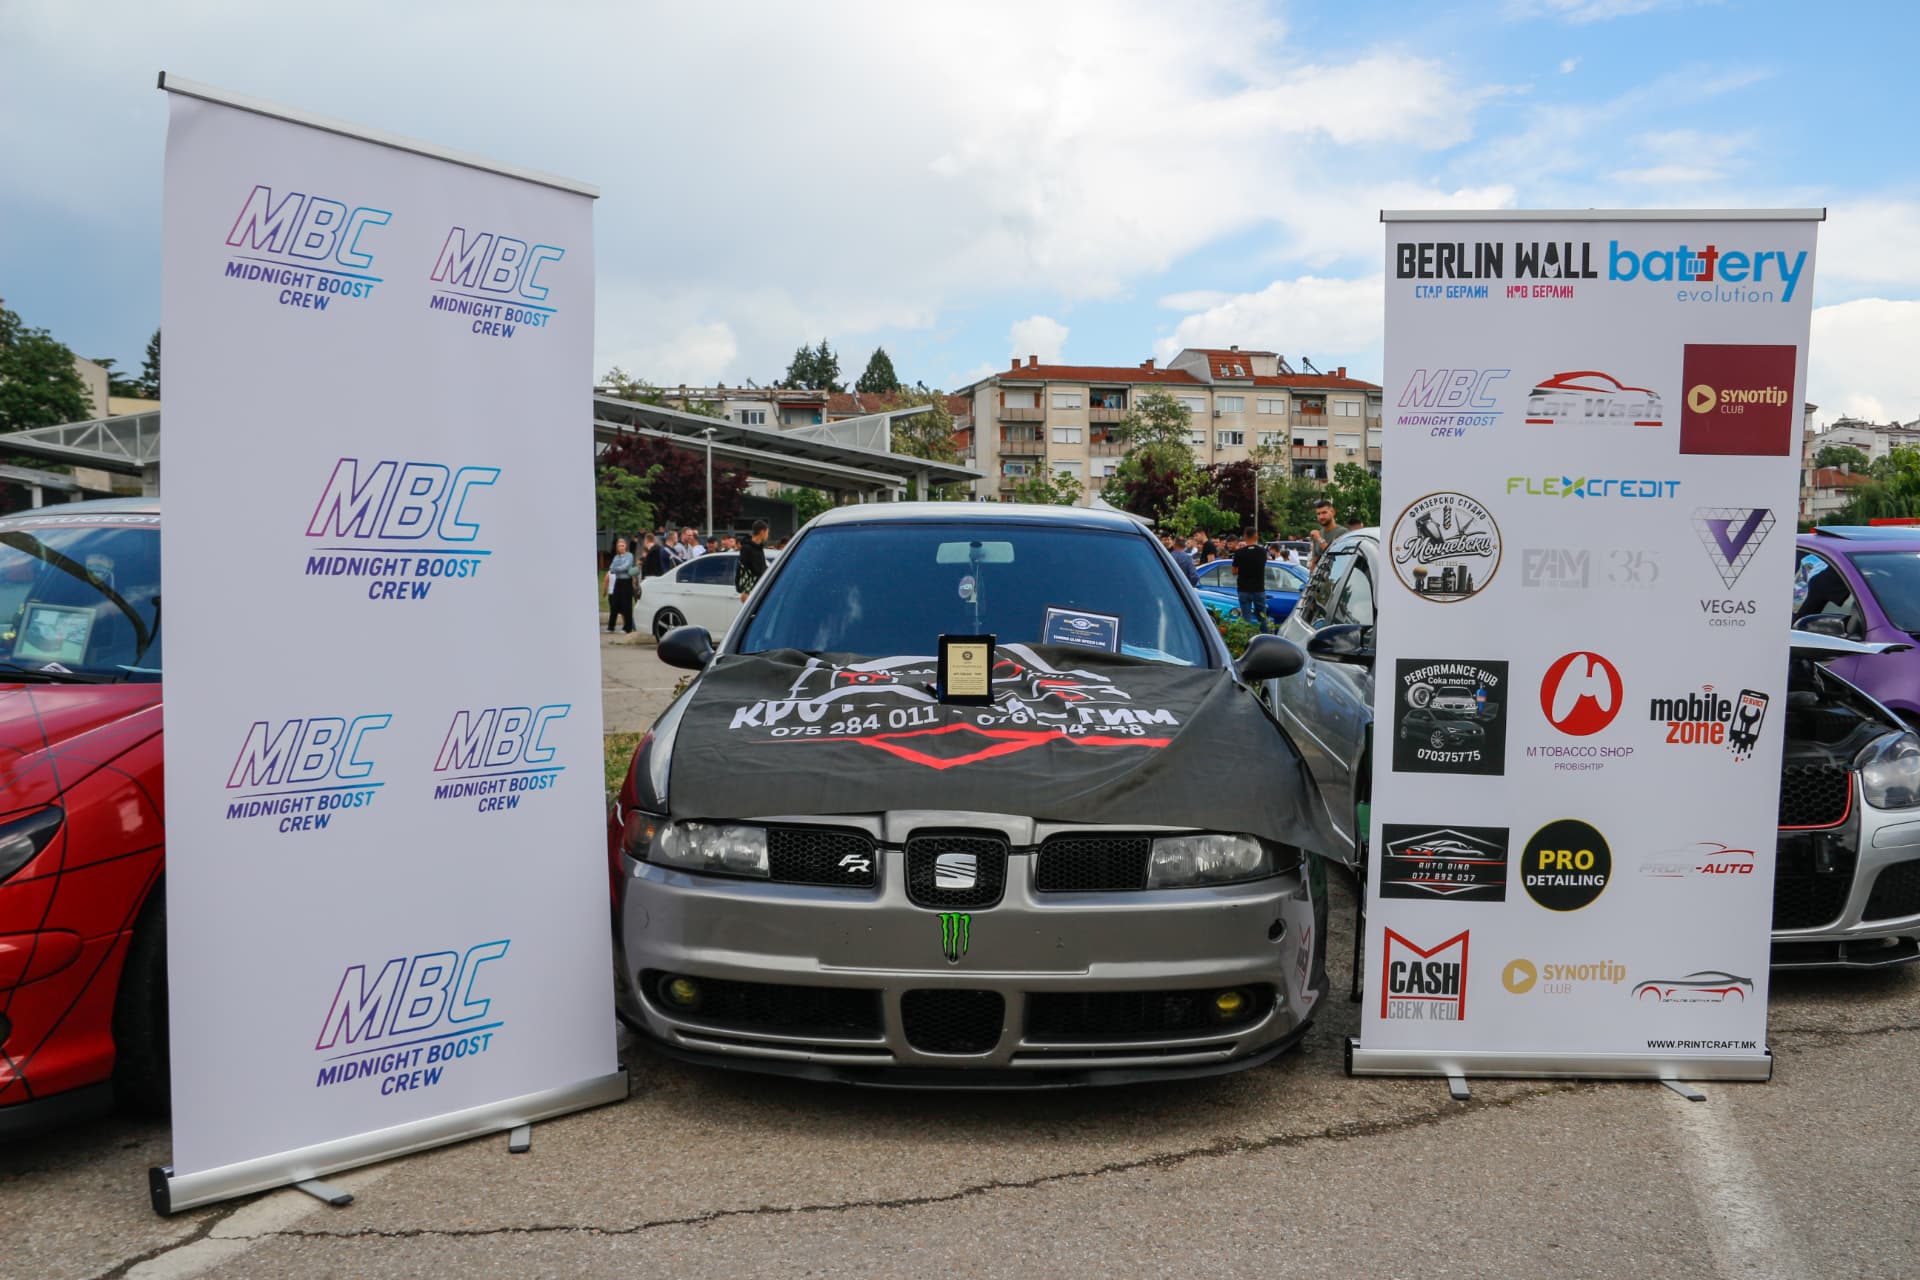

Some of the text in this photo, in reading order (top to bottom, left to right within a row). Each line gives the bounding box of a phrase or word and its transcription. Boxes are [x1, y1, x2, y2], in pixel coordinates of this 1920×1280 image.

[226, 185, 392, 268] MBC
[430, 227, 565, 300] MBC
[1397, 242, 1598, 279] BERLIN WALL
[1609, 240, 1808, 302] battery
[224, 261, 374, 299] MIDNIGHT BOOST
[278, 290, 330, 311] CREW
[1446, 285, 1488, 298] БЕРЛИН
[1532, 285, 1574, 299] БЕРЛИН
[1676, 285, 1773, 303] evolution
[429, 295, 550, 328] MIDNIGHT BOOST
[471, 320, 515, 338] CREW
[1398, 369, 1511, 408] MBC
[1526, 398, 1663, 419] Car Wash
[1720, 405, 1744, 414] CLUB
[1397, 415, 1496, 427] MIDNIGHT BOOST
[1430, 427, 1465, 438] CREW
[305, 458, 501, 542] MBC
[1409, 496, 1487, 520] ФРИЗЕРСКО СТУДИО
[305, 556, 482, 579] MIDNIGHT BOOST
[368, 581, 432, 600] CREW
[1700, 600, 1756, 614] VEGAS
[1709, 617, 1746, 627] casino
[1404, 664, 1499, 687] PERFORMANCE HUB
[1427, 676, 1476, 685] Coka motors
[1650, 692, 1732, 722] mobile
[1742, 696, 1764, 708] SERVICE
[770, 726, 822, 736] 075
[829, 714, 881, 734] 284
[889, 705, 939, 728] 011
[434, 704, 571, 771] MBC
[1666, 721, 1725, 745] zone
[226, 714, 393, 788] MBC
[1417, 748, 1481, 763] 070375775
[1526, 746, 1634, 758] M TOBACCO SHOP
[434, 773, 557, 800] MIDNIGHT BOOST
[226, 790, 376, 820] MIDNIGHT BOOST
[477, 795, 521, 813] CREW
[278, 814, 331, 833] CREW
[1418, 862, 1443, 870] AUTO
[1538, 849, 1594, 871] PRO
[1412, 872, 1430, 880] 077
[1526, 873, 1604, 886] DETAILING
[1389, 961, 1460, 995] CASH
[315, 939, 511, 1050] MBC
[1543, 984, 1571, 994] CLUB
[1388, 1001, 1458, 1021] СВЕЖ КЕШ
[1647, 1040, 1757, 1049] WWW.PRINTCRAFT.MK
[316, 1033, 493, 1088] MIDNIGHT BOOST
[380, 1067, 443, 1096] CREW
